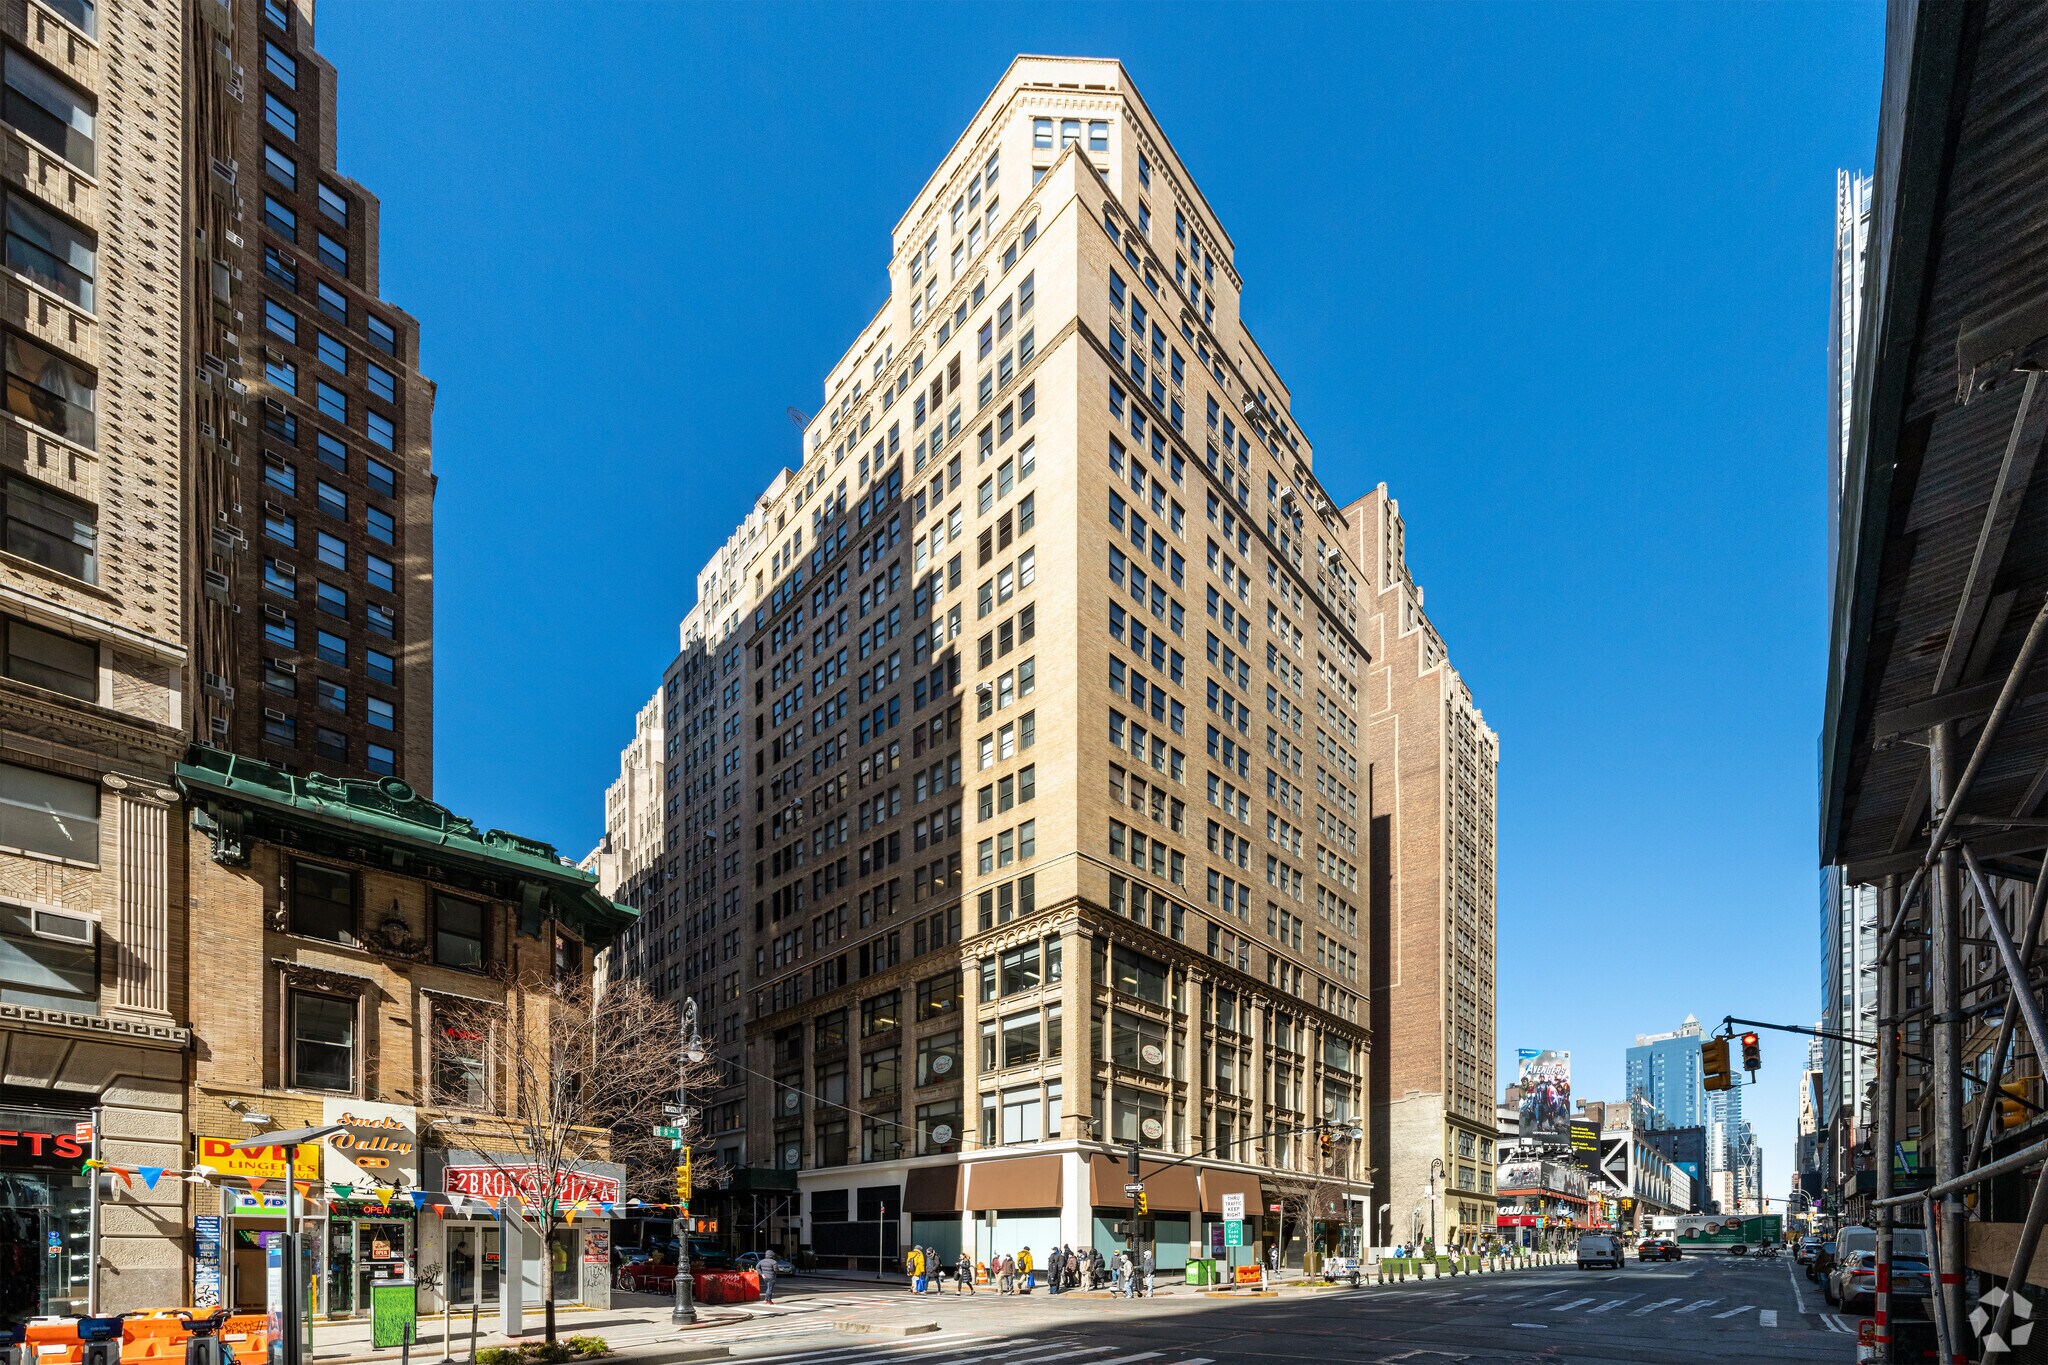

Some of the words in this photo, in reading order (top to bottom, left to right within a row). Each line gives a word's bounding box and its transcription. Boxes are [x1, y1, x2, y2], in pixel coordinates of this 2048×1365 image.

[1520, 1063, 1566, 1076] AVENGERS
[337, 1112, 405, 1131] Smoke
[204, 1140, 299, 1161] DVD
[327, 1133, 414, 1155] Valley
[363, 1206, 390, 1214] OPEN
[709, 1221, 717, 1232] 19
